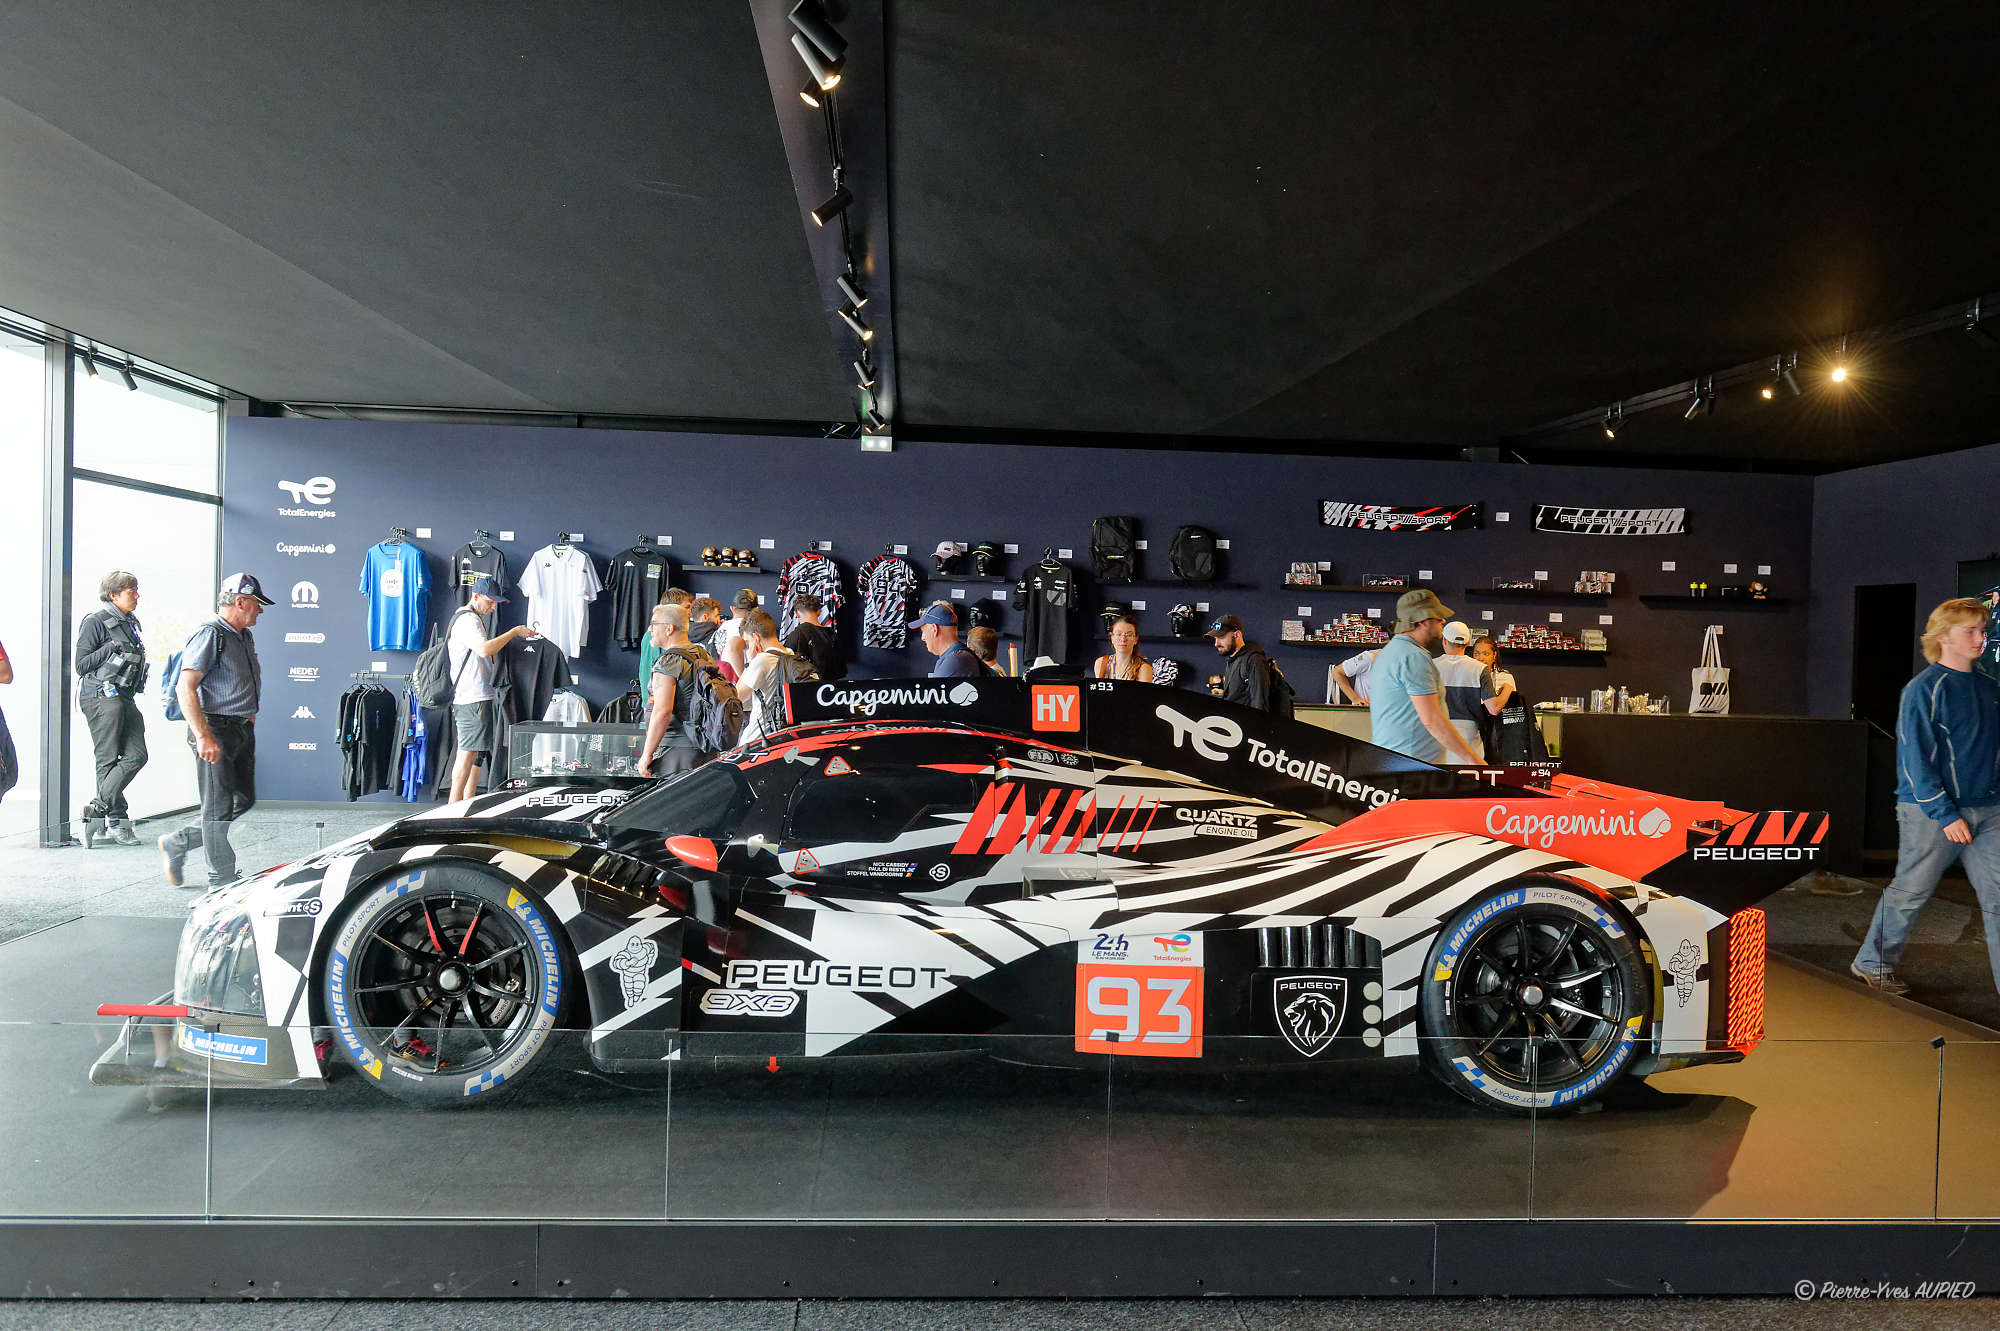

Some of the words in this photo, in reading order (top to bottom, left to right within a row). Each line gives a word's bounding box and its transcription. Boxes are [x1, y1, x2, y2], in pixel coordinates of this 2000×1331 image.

[277, 508, 336, 519] TotalEnergies
[276, 541, 325, 557] Capgemini
[289, 667, 319, 676] NEDEY
[1090, 682, 1114, 692] #93
[816, 683, 948, 716] Capgemini
[1037, 694, 1075, 722] HY
[1531, 769, 1551, 777] #94
[1175, 807, 1258, 828] QUARTZ
[1486, 804, 1636, 848] Capgemini
[1206, 826, 1240, 837] ENGINE
[1241, 828, 1255, 838] OIL
[1693, 847, 1820, 861] PEUGEOT
[1533, 891, 1558, 900] PILOT
[1559, 894, 1587, 909] SPORT
[341, 921, 356, 948] PILOT
[356, 897, 380, 921] SPORT
[1451, 892, 1519, 951] MICHELIN
[1093, 933, 1129, 951] 24h
[528, 918, 557, 1008] MICHELIN
[1153, 954, 1192, 962] TotalEnergies
[731, 964, 947, 989] PEUGEOT
[1280, 982, 1341, 991] PEUGEOT
[332, 960, 361, 1051] MICHELIN
[704, 991, 796, 1013] 9X8
[1087, 976, 1193, 1044] 93
[531, 1019, 549, 1046] PILOT
[195, 1037, 258, 1056] MICHELIN
[510, 1045, 533, 1071] SPORT
[1560, 1046, 1629, 1104] MICHELIN
[1490, 1087, 1520, 1101] SPORT
